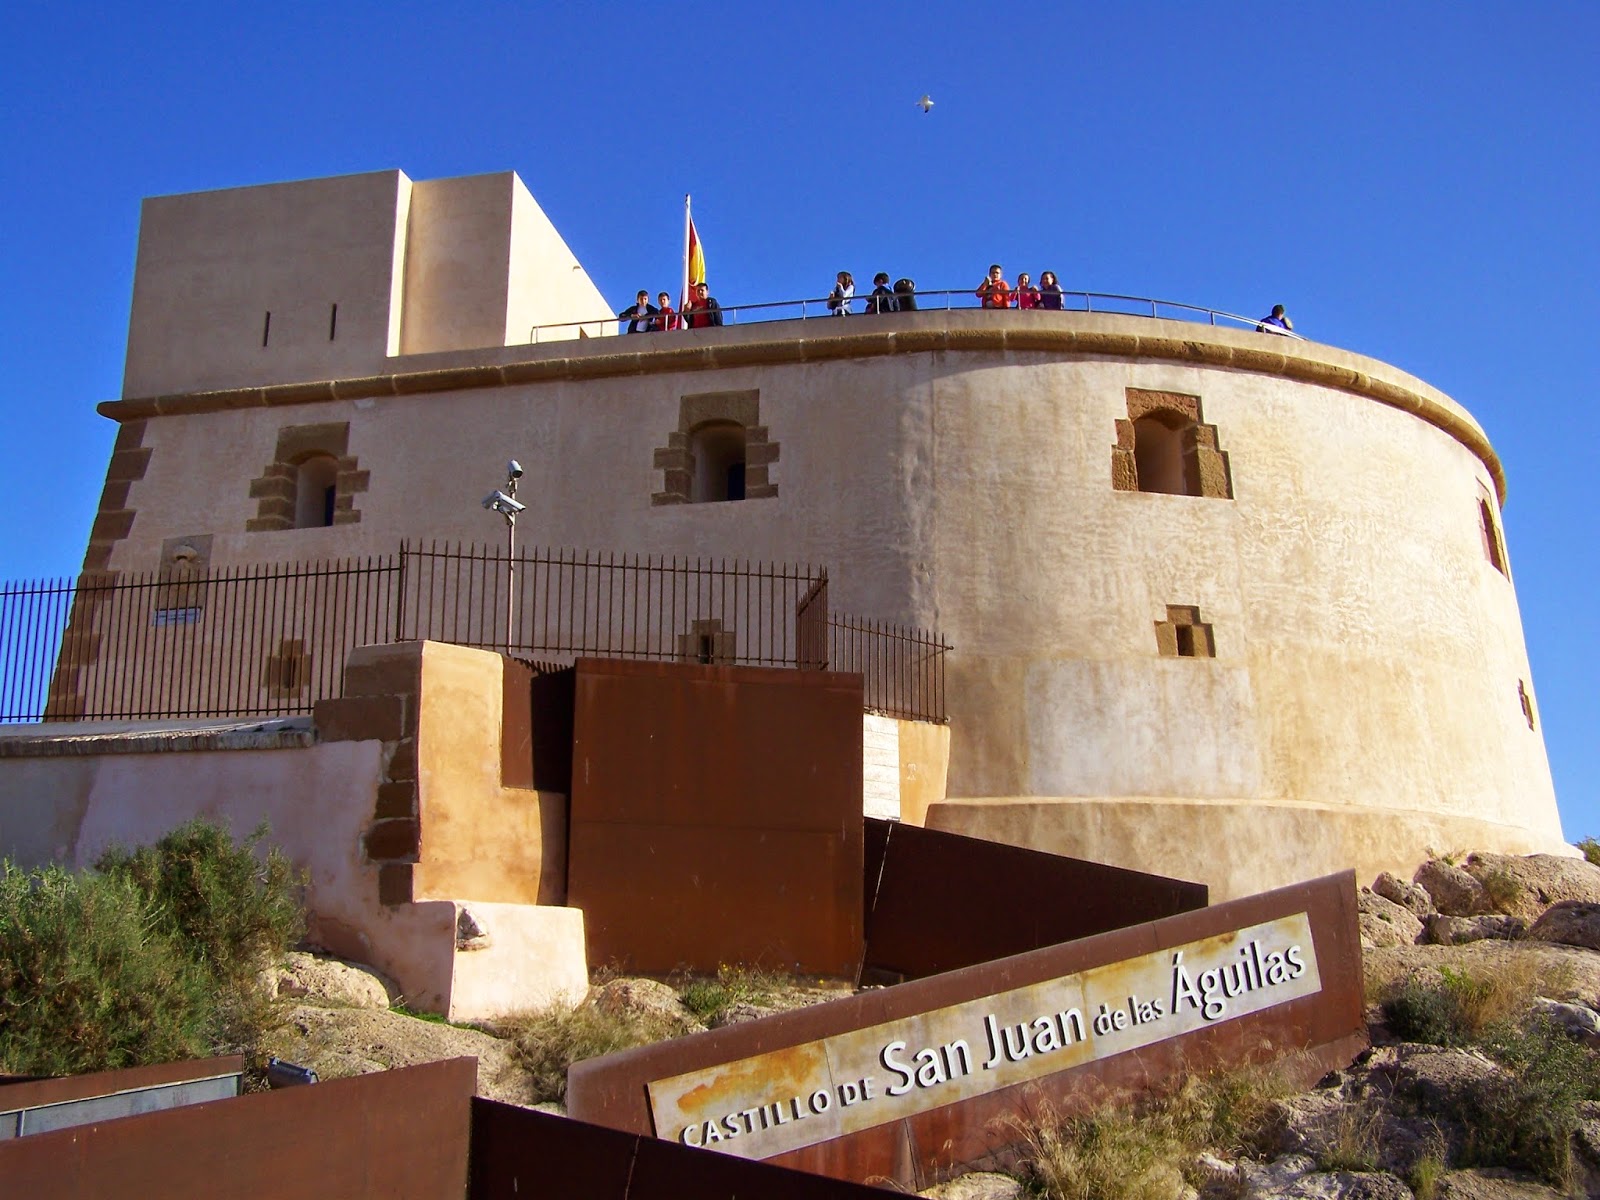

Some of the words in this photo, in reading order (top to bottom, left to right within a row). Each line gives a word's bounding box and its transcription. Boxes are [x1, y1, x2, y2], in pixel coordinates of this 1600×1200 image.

[682, 1088, 833, 1147] CASTILLO
[841, 1077, 876, 1107] DE
[881, 1038, 974, 1097] San
[985, 1005, 1088, 1071] Juan
[1096, 1002, 1127, 1036] de
[1132, 995, 1165, 1026] las
[1174, 939, 1307, 1021] Águilas
